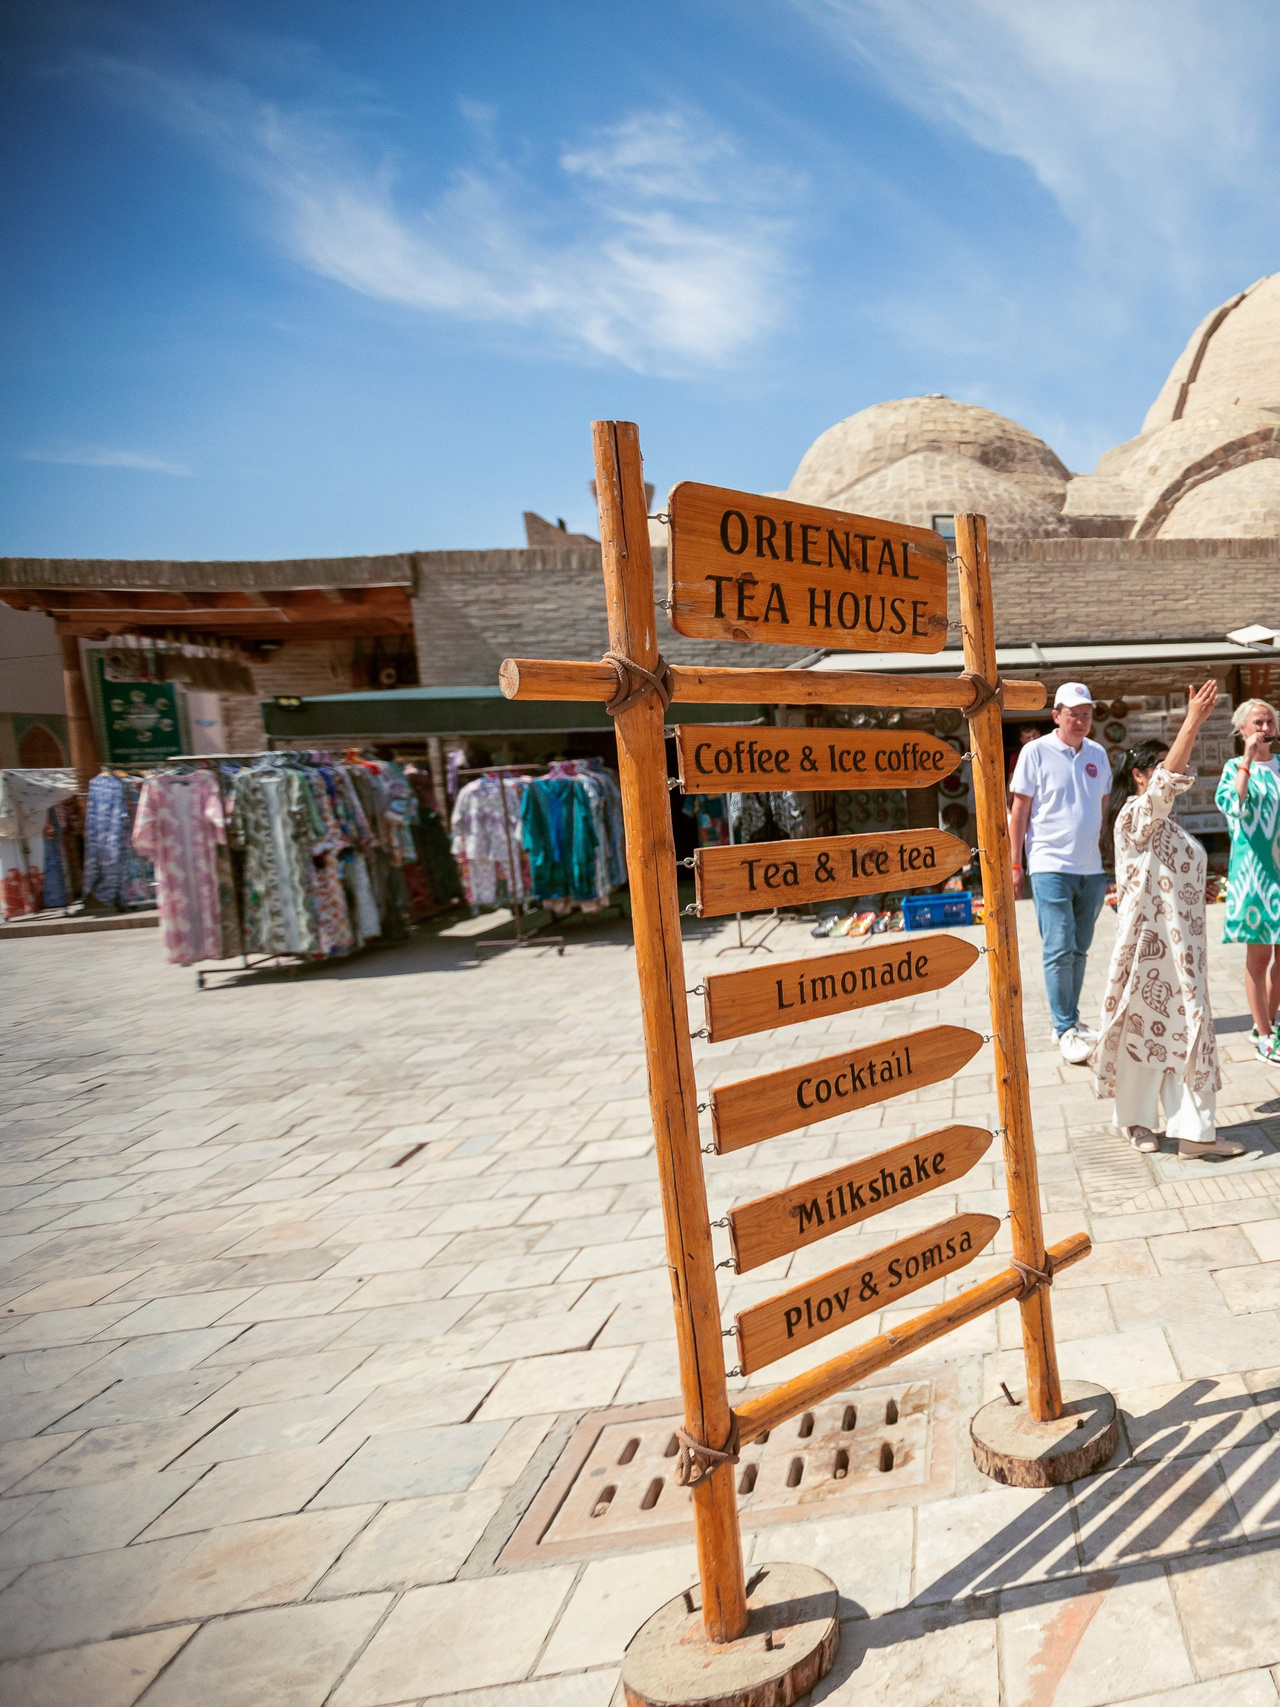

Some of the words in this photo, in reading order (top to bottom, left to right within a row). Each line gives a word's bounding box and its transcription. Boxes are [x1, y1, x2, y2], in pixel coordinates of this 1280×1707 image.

[720, 510, 919, 580] ORIENTAL
[705, 574, 789, 624] TEA
[807, 587, 929, 637] HOUSE
[694, 740, 791, 774] Coffee
[800, 745, 819, 772] &
[828, 744, 867, 773] Ice
[875, 743, 945, 772] coffee
[740, 858, 799, 891] Tea
[815, 852, 836, 883] &
[851, 848, 890, 878] Ice
[898, 844, 937, 872] tea
[776, 951, 929, 1010] Limonade
[796, 1047, 913, 1109] Cocktail
[797, 1151, 946, 1234] Milkshake
[784, 1287, 850, 1339] Plov
[858, 1271, 880, 1302] &
[887, 1231, 973, 1288] Somsa
